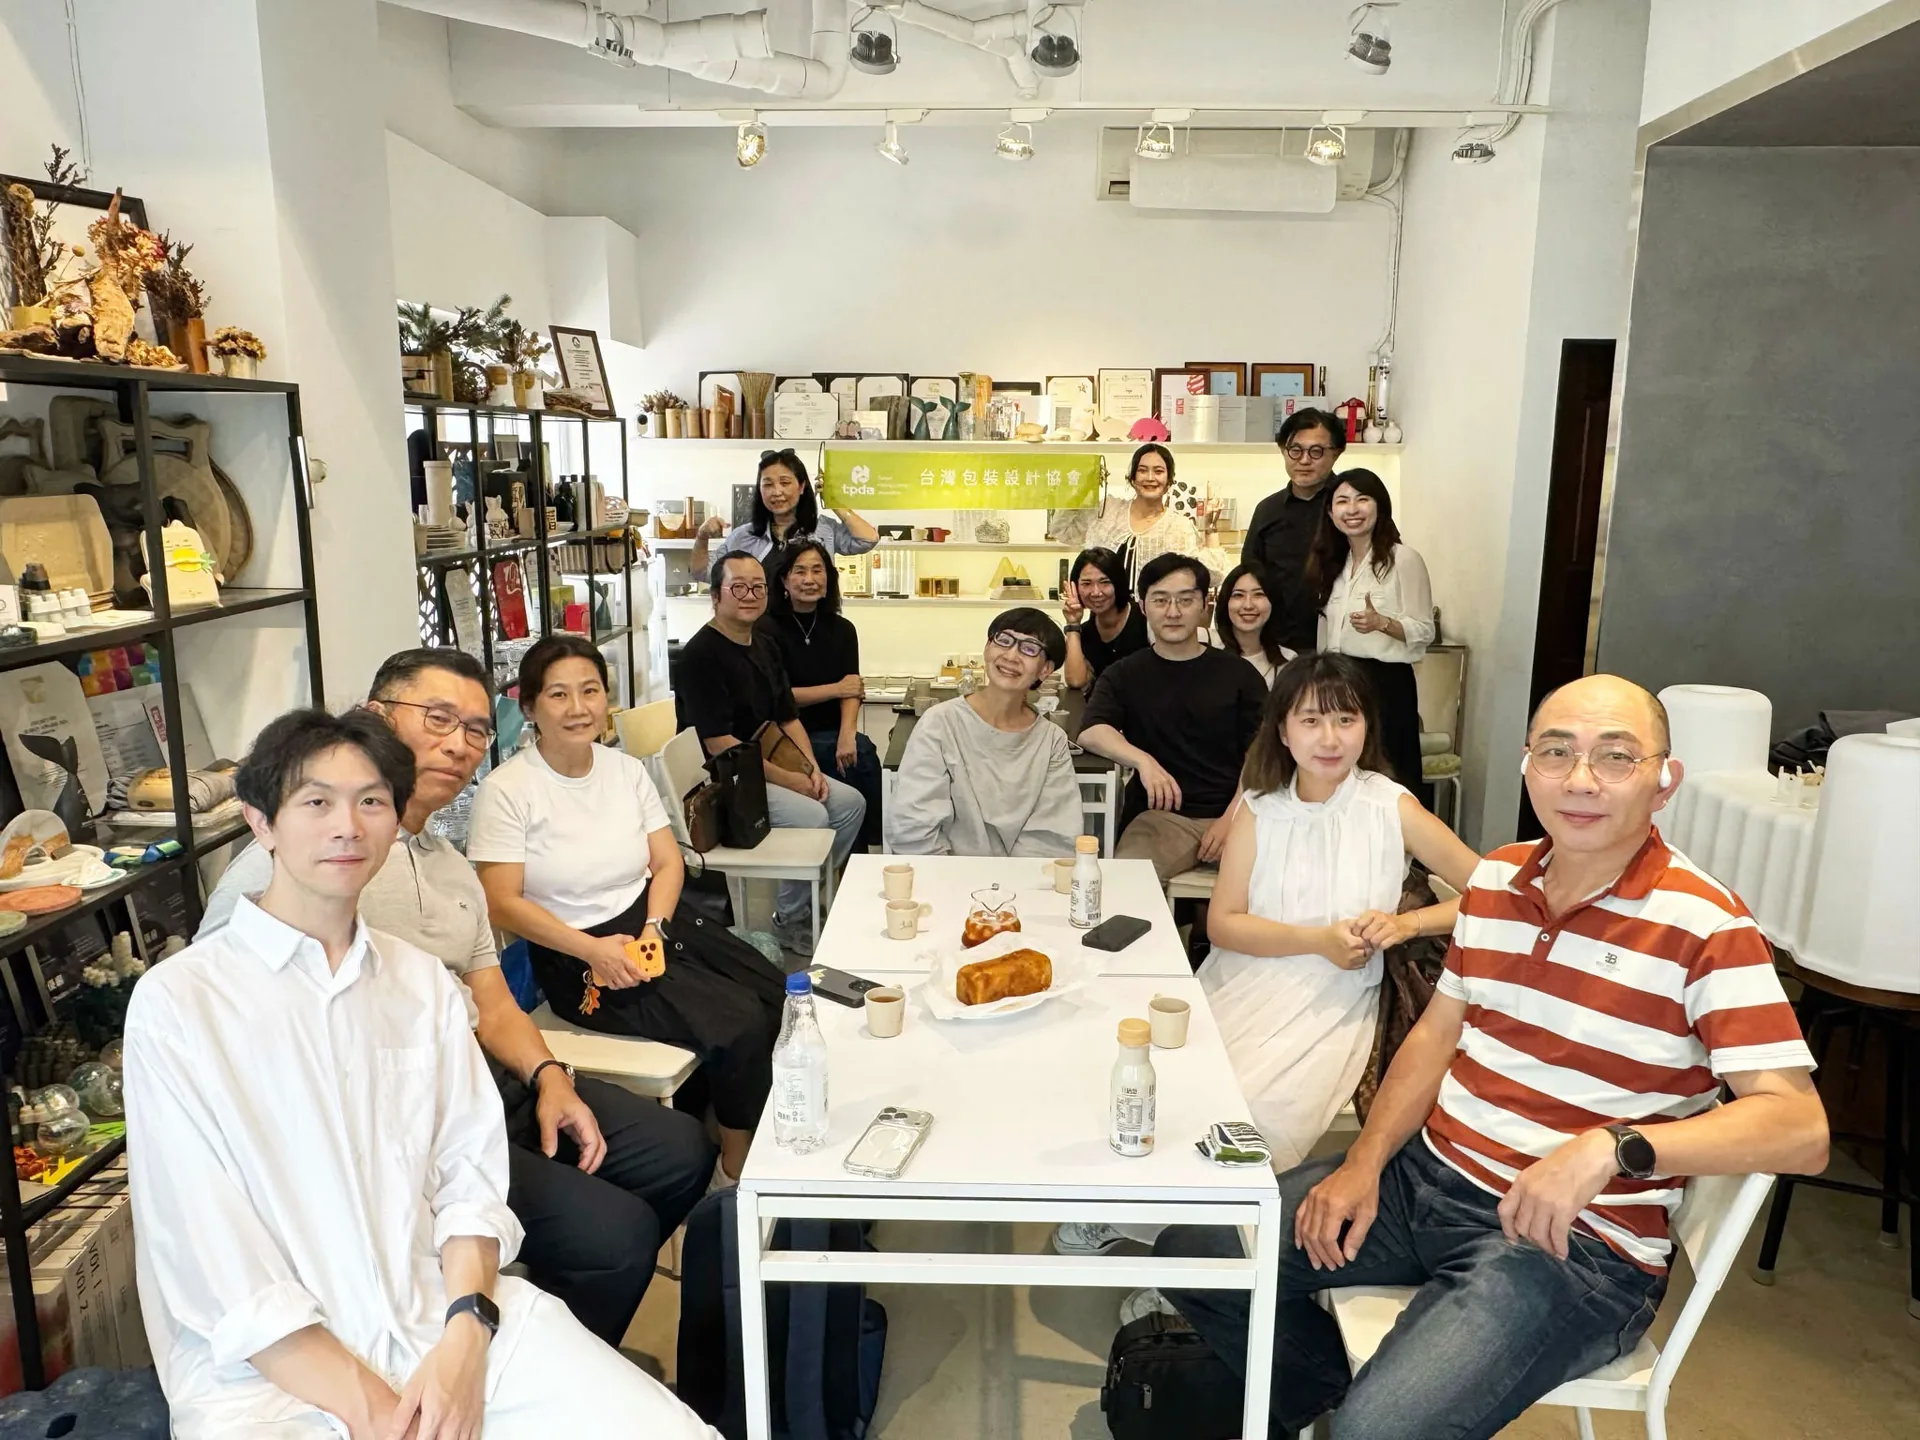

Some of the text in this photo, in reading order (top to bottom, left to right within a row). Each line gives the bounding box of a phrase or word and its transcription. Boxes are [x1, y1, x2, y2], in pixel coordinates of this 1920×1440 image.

[920, 469, 1081, 486] 台灣包裝設計協會
[841, 484, 875, 497] tpda
